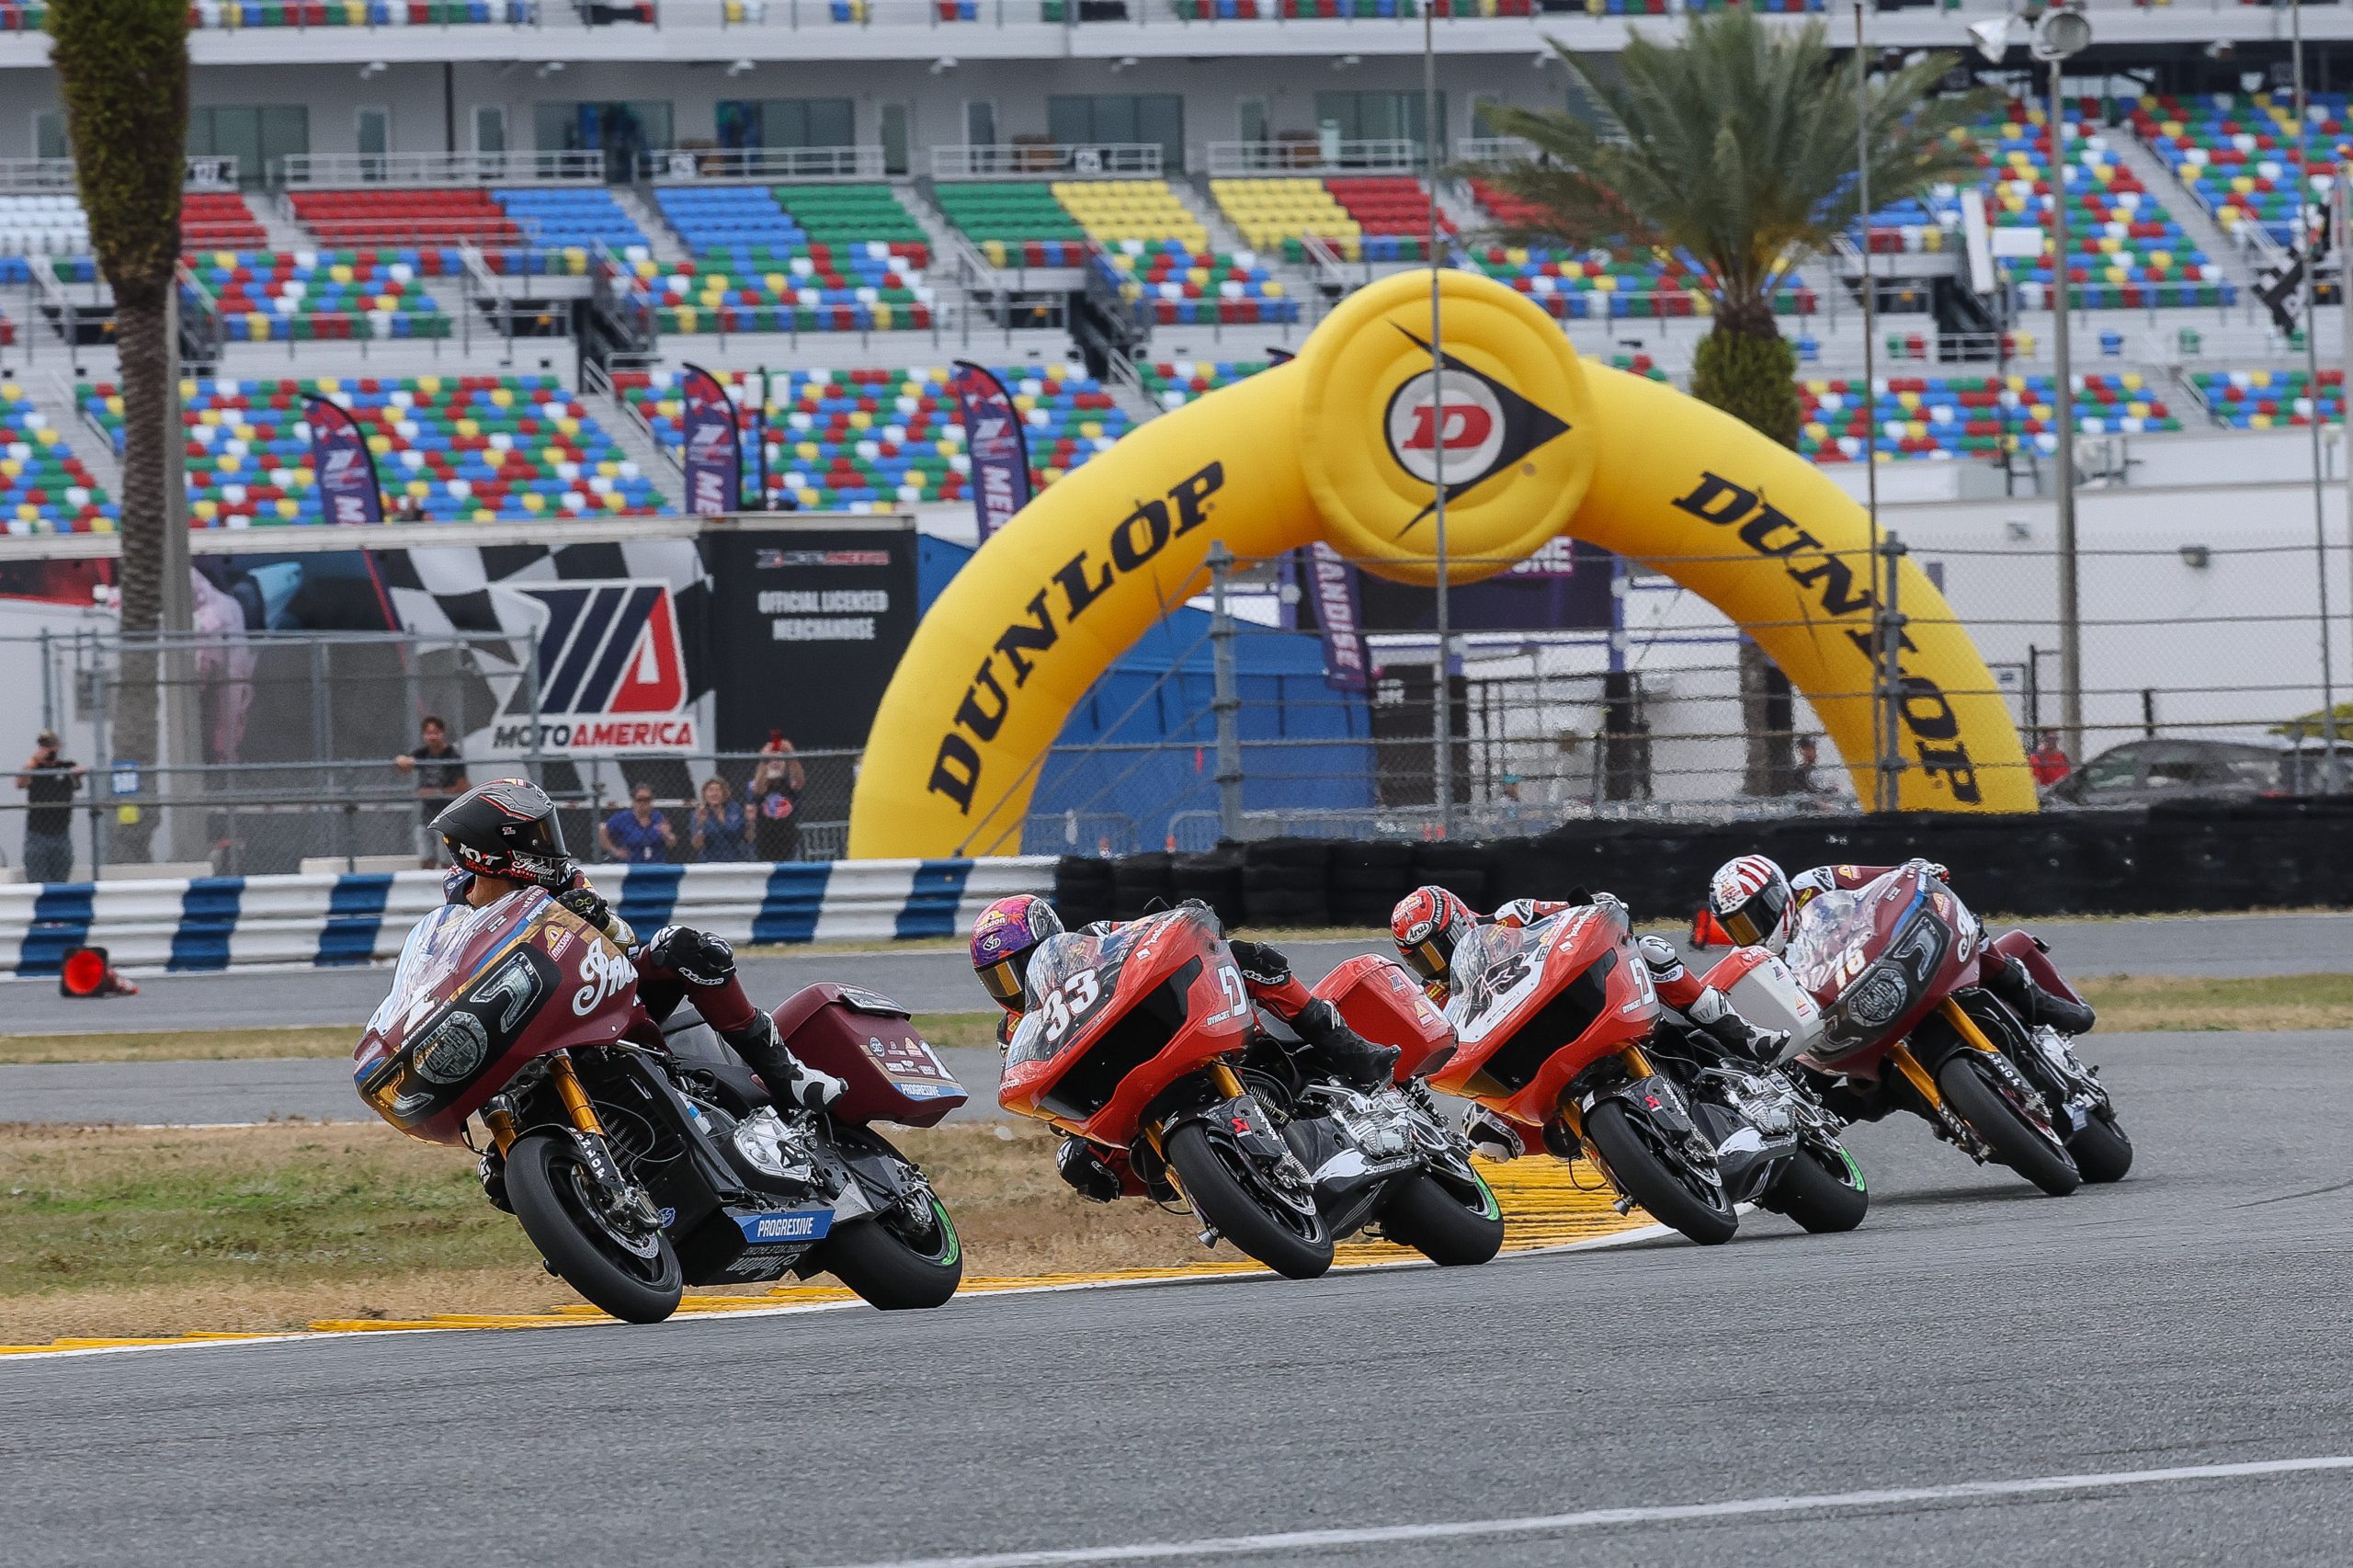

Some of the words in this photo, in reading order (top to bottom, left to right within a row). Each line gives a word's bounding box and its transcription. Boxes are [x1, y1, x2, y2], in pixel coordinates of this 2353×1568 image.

[926, 460, 1225, 816] DUNLOP
[493, 722, 692, 749] MOTOAMERICA
[1407, 922, 1427, 938] Arai
[1042, 968, 1101, 1043] 33
[756, 1217, 814, 1238] PROGRESSIVE
